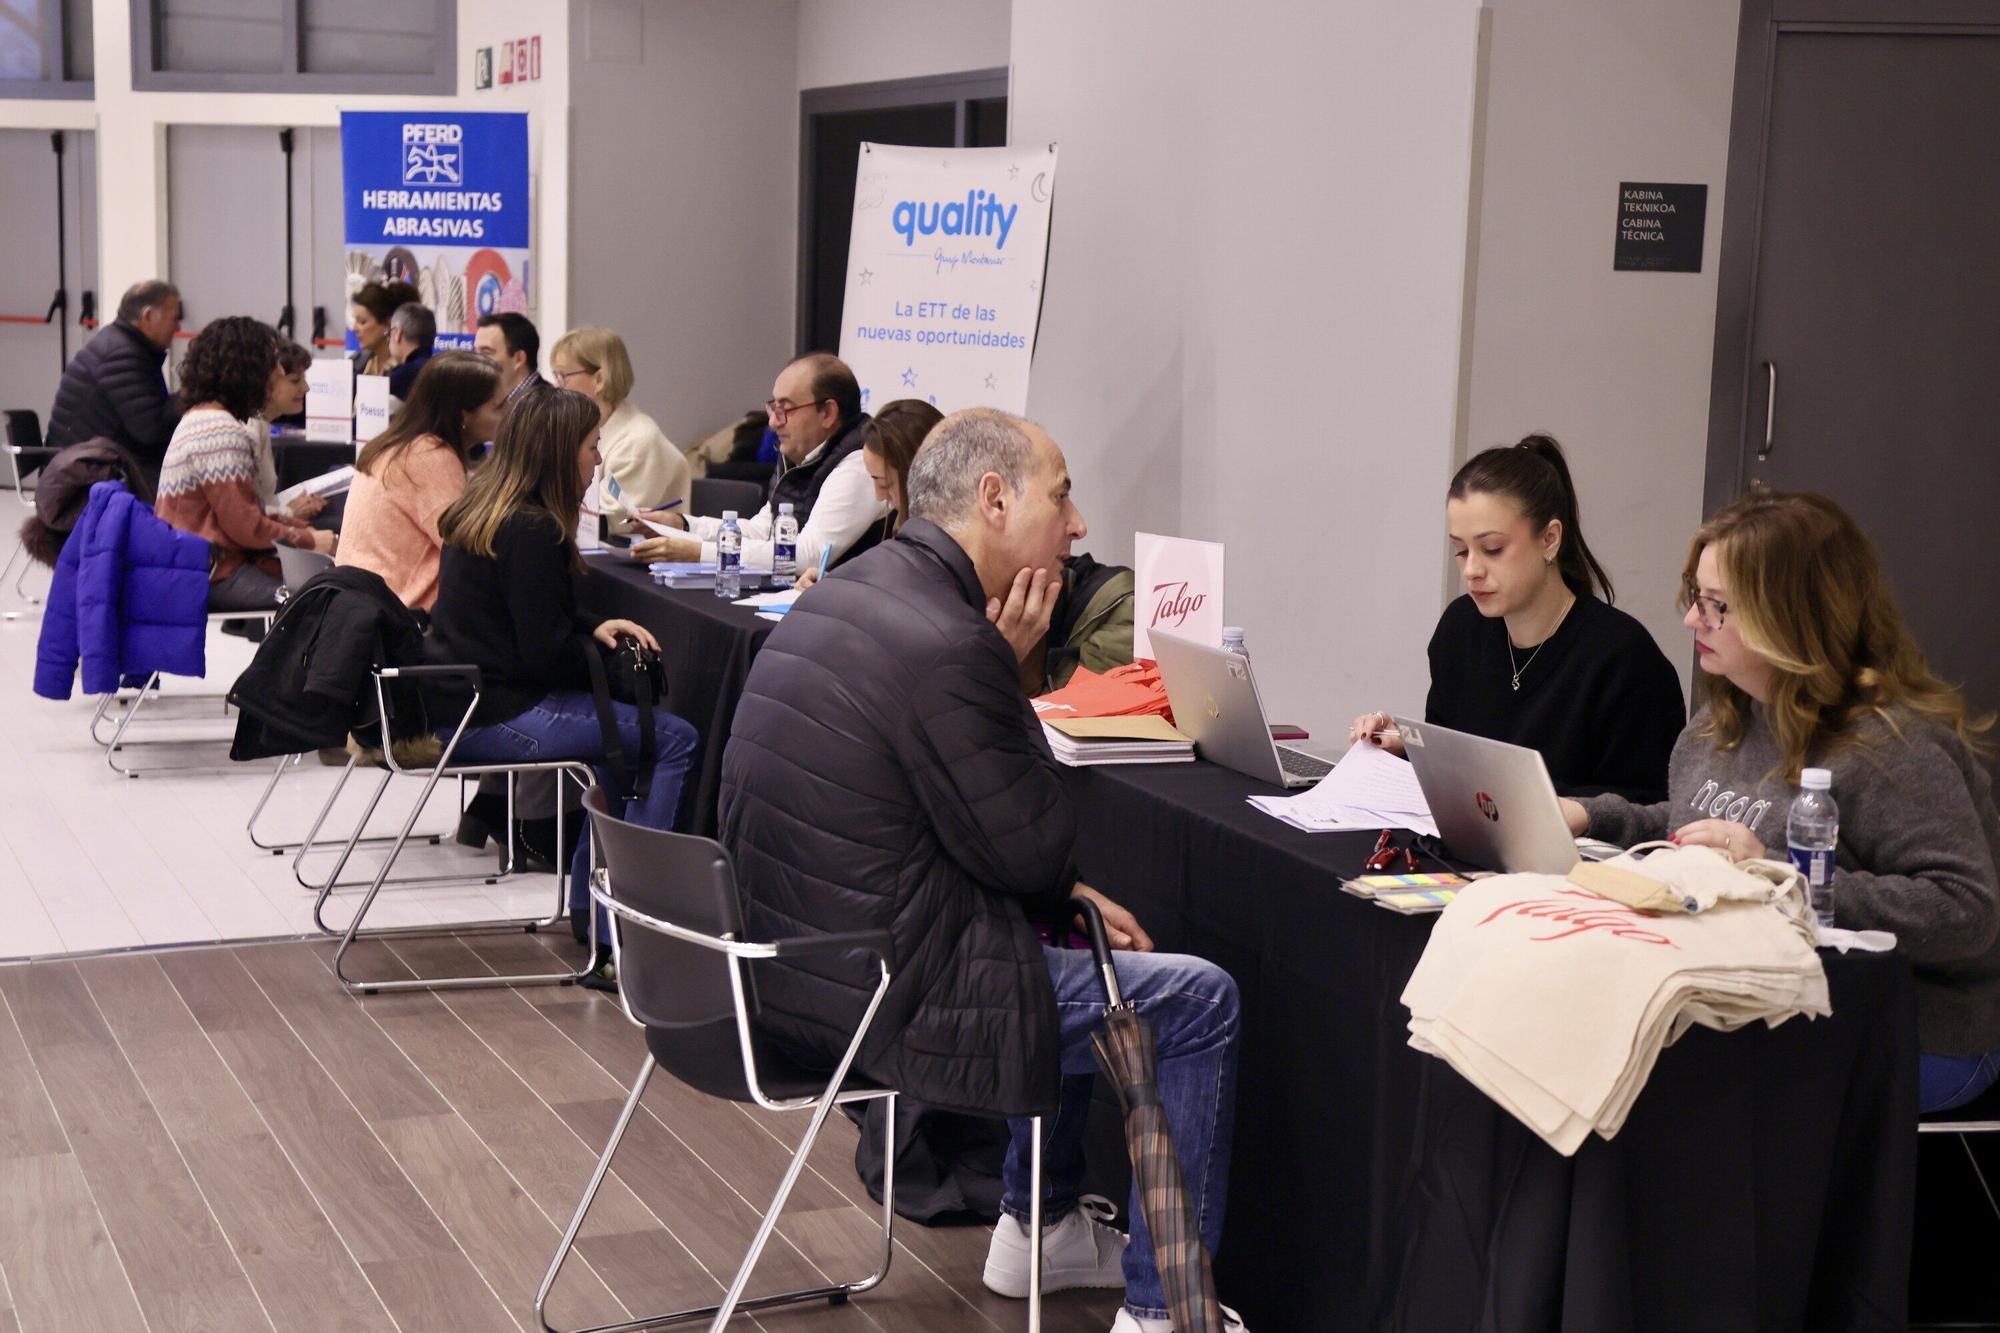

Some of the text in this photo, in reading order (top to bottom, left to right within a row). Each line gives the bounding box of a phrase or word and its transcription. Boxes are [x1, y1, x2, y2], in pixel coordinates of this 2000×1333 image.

[402, 123, 463, 143] PFERD
[362, 189, 503, 212] HERRAMIENTAS
[1624, 190, 1664, 200] KABINA
[1624, 202, 1676, 213] TEKNIKOA
[382, 216, 485, 239] ABRASIVAS
[892, 189, 1018, 250] quality
[1622, 218, 1662, 228] CABINA
[1621, 229, 1665, 241] TÉCNICA
[895, 301, 996, 321] La ETT de las
[857, 325, 1025, 349] nuevas oportunidades
[1150, 580, 1207, 628] Talgo
